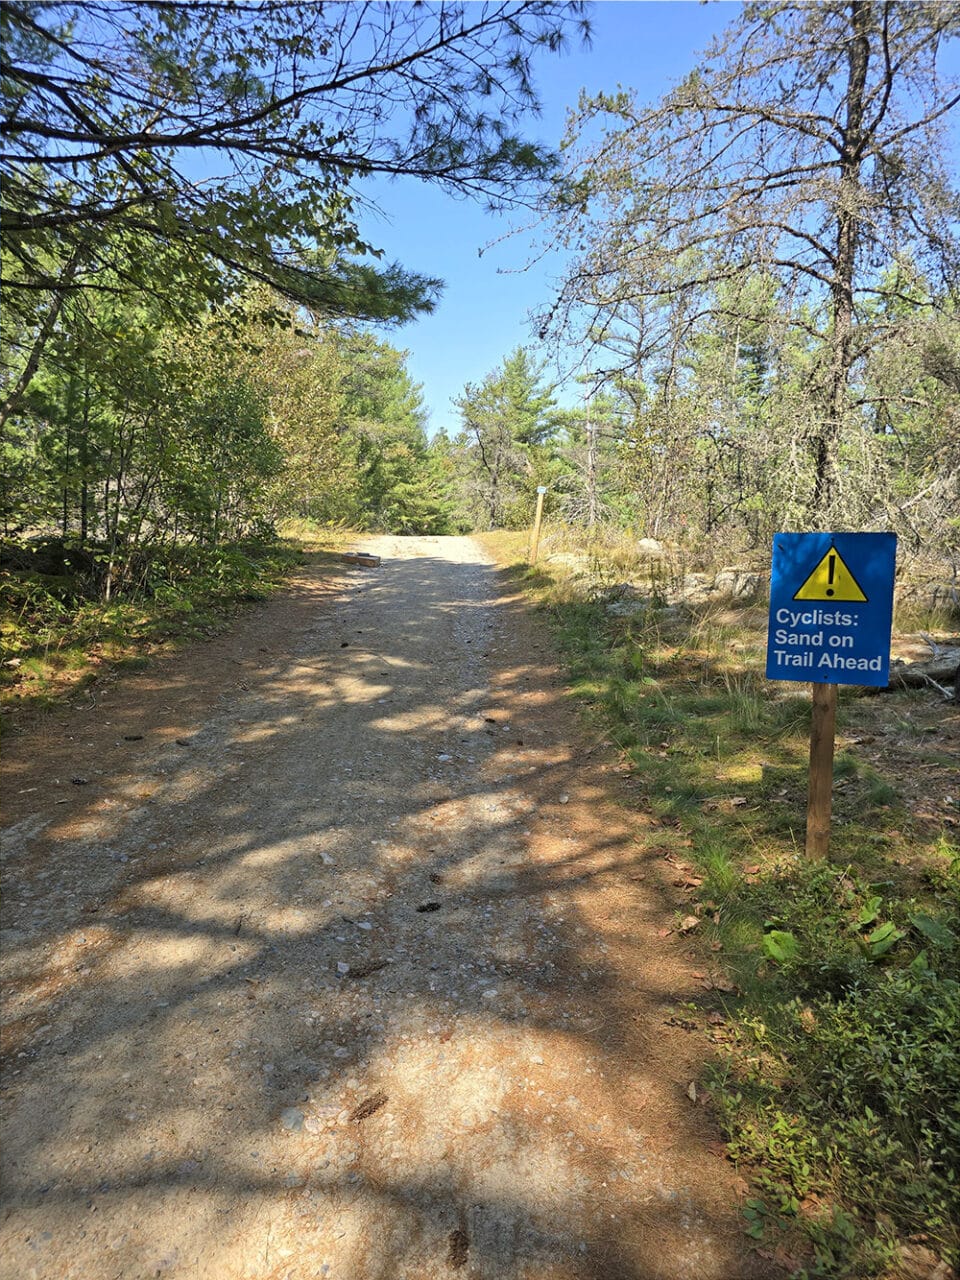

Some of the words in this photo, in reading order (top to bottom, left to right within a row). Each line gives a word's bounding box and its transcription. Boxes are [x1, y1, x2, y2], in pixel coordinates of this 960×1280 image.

[776, 608, 858, 628] Cyclists:
[775, 629, 823, 646] Sand
[829, 635, 854, 647] on
[774, 650, 813, 667] Trail
[817, 652, 882, 671] Ahead
